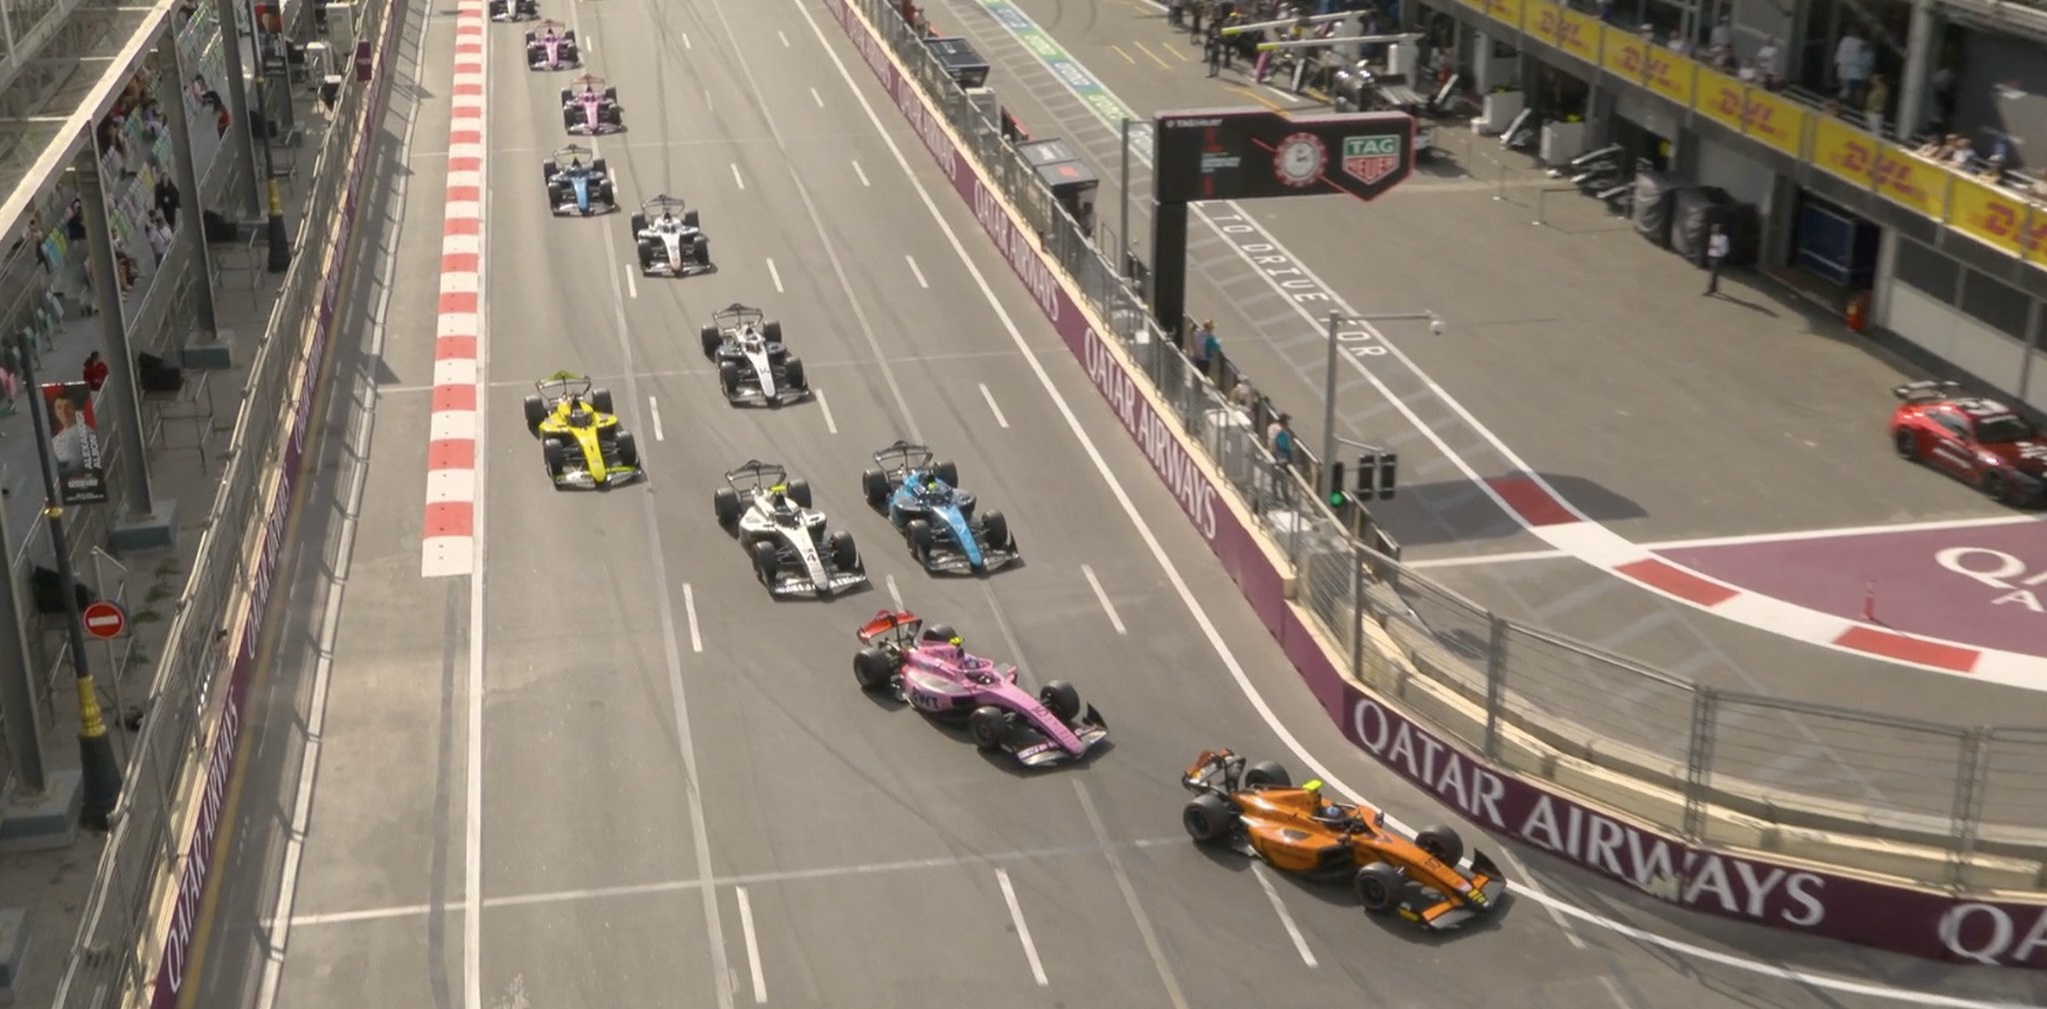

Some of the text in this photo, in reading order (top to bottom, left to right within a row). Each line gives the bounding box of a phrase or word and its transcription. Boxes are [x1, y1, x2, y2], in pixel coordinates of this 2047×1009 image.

[1350, 139, 1395, 154] TAG
[1212, 214, 1253, 233] TO
[1240, 243, 1330, 303] DRIVE
[1084, 327, 1217, 540] QATAR AIRWAYS
[1354, 698, 1826, 927] QATAR AIRWAYS
[167, 824, 207, 994] QATAR
